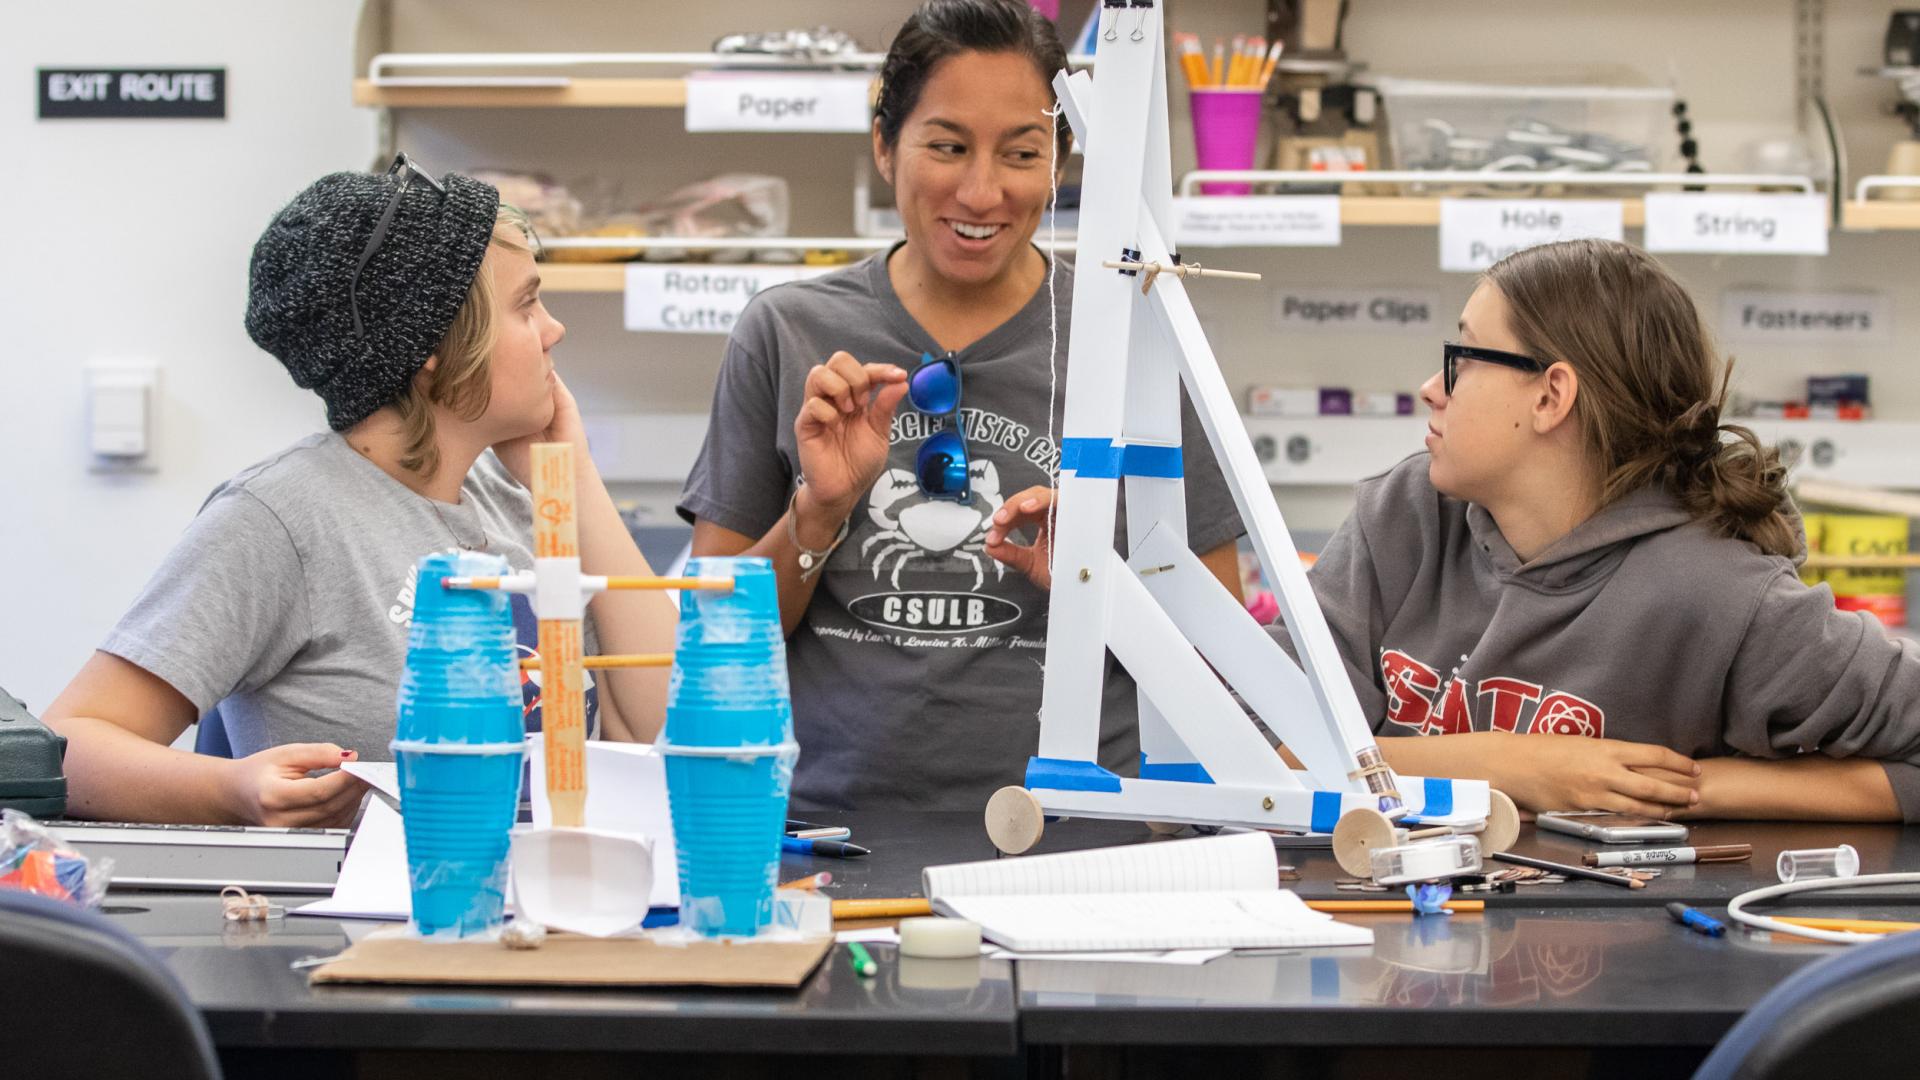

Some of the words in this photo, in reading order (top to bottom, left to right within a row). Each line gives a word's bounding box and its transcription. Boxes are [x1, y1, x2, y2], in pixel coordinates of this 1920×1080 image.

[49, 73, 111, 100] EXIT
[120, 73, 214, 100] ROUTE
[738, 93, 818, 119] Paper
[1501, 209, 1562, 229] Hole
[1694, 211, 1776, 240] String
[664, 272, 760, 297] Rotary
[661, 305, 740, 329] Cutte
[1283, 297, 1359, 322] Paper
[1369, 298, 1431, 325] Clips
[1743, 306, 1873, 331] Fasteners
[883, 597, 986, 625] CSULB
